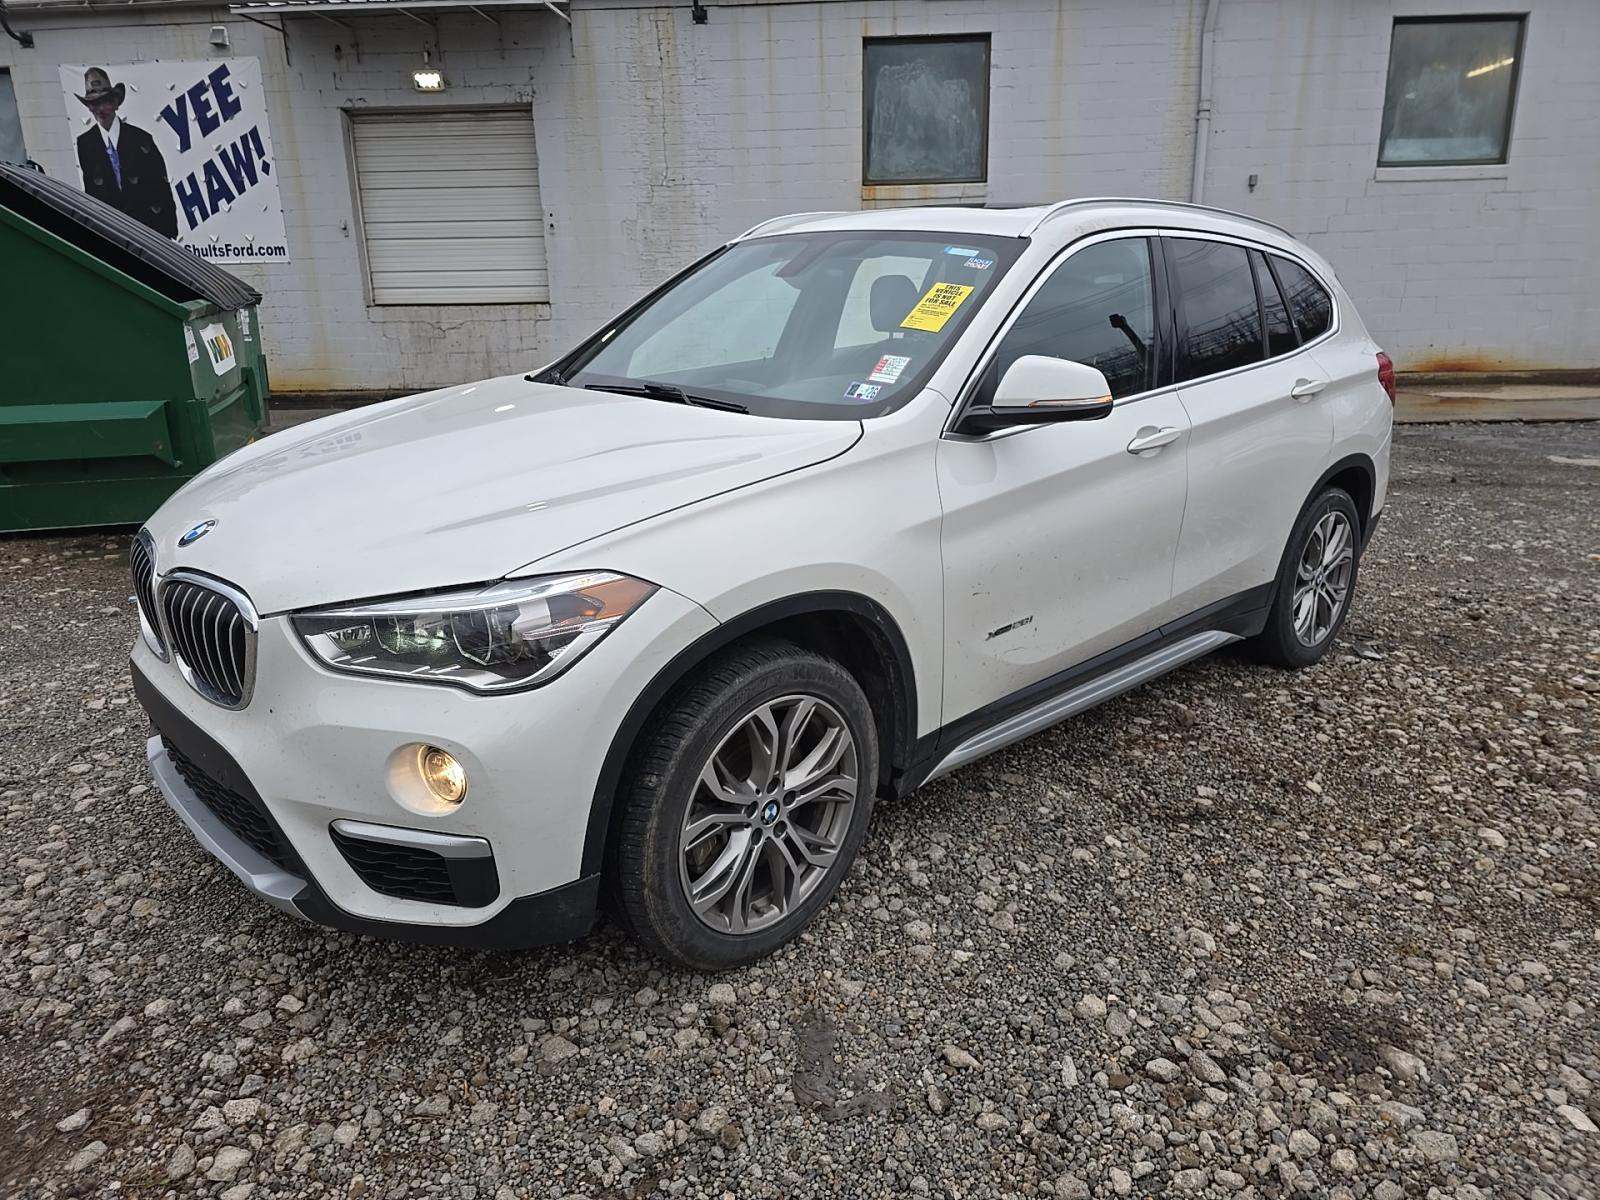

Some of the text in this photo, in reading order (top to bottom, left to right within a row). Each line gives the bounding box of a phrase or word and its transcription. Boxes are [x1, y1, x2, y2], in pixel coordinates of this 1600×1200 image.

[160, 63, 242, 154] YEE
[175, 125, 271, 231] HAW!
[184, 242, 286, 258] ShultsFord.com
[936, 288, 963, 297] VEHICLE
[939, 299, 956, 307] SALE
